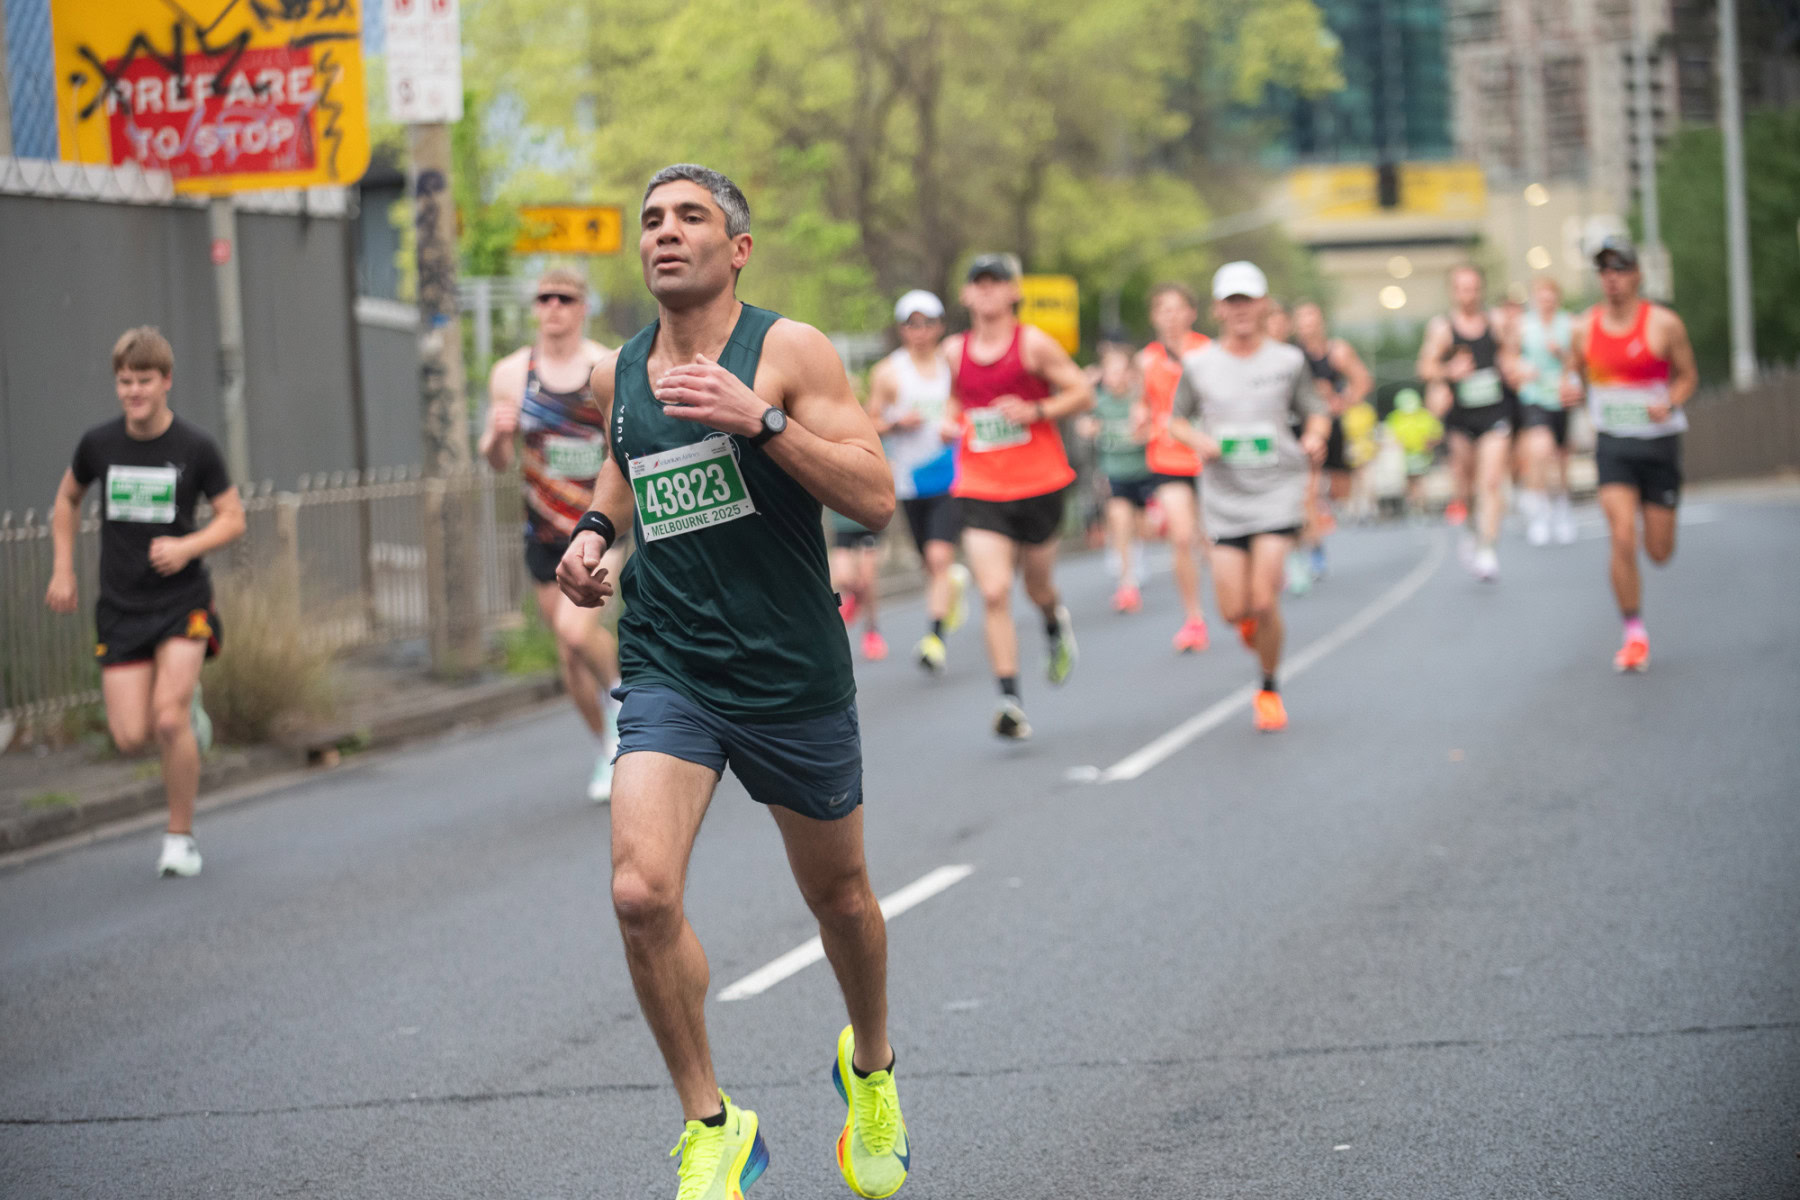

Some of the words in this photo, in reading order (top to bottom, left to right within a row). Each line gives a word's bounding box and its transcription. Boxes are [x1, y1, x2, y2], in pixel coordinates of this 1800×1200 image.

[136, 126, 181, 160] TO
[194, 118, 295, 157] STOP
[646, 463, 731, 518] 43823
[651, 513, 711, 537] MELBOURNE
[711, 504, 741, 522] 2025
